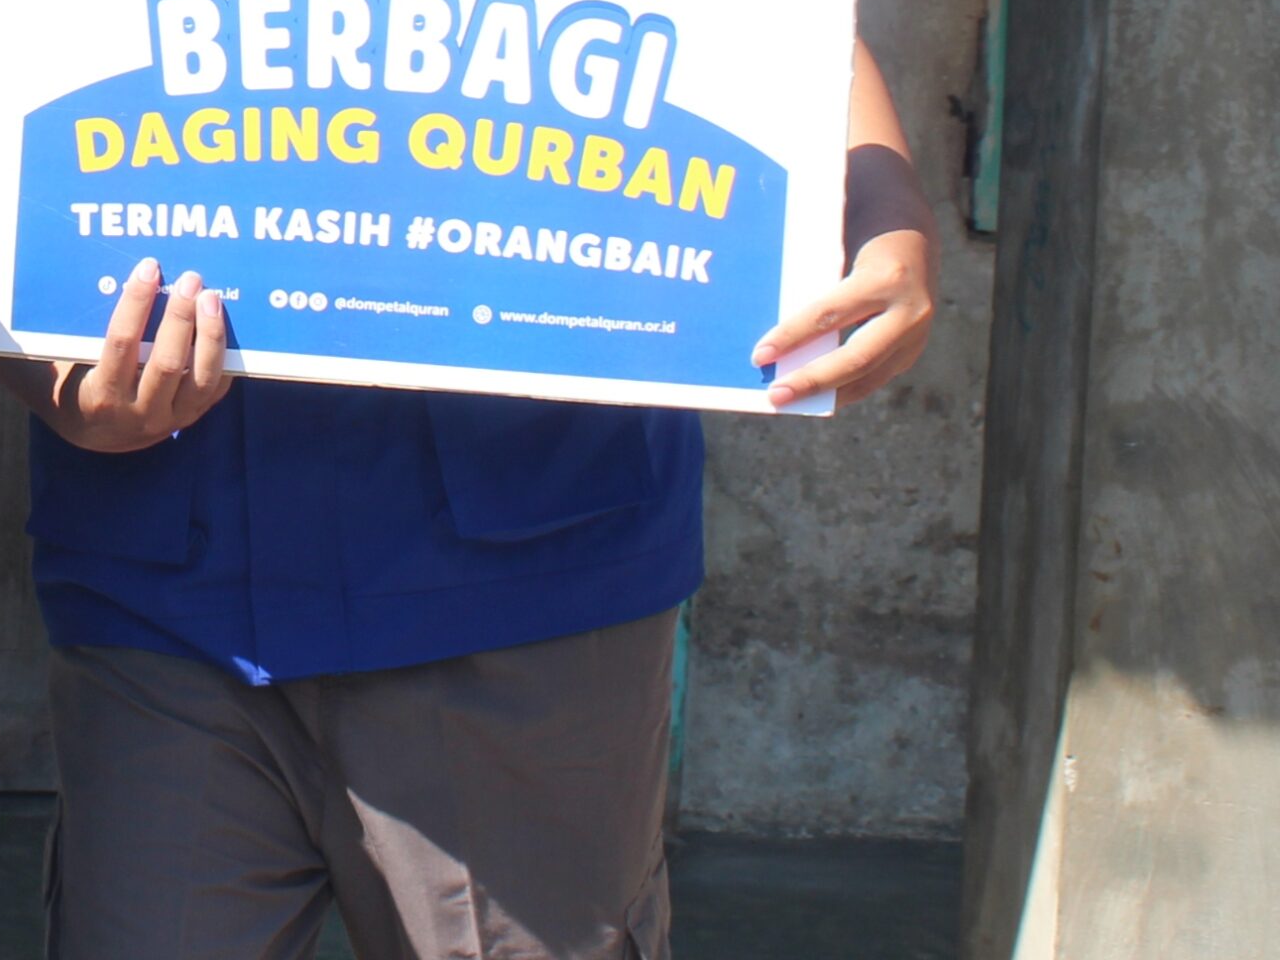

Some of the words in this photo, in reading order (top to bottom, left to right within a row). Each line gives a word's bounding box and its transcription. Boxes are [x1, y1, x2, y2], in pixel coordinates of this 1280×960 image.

[75, 106, 380, 173] DAGING
[408, 112, 736, 219] QURBAN
[70, 202, 239, 239] TERIMA
[253, 205, 390, 247] KASIH
[405, 215, 713, 283] #ORANGBAIK
[334, 296, 449, 318] @dompetalquran
[500, 309, 676, 334] www.dompetalquran.or.id
